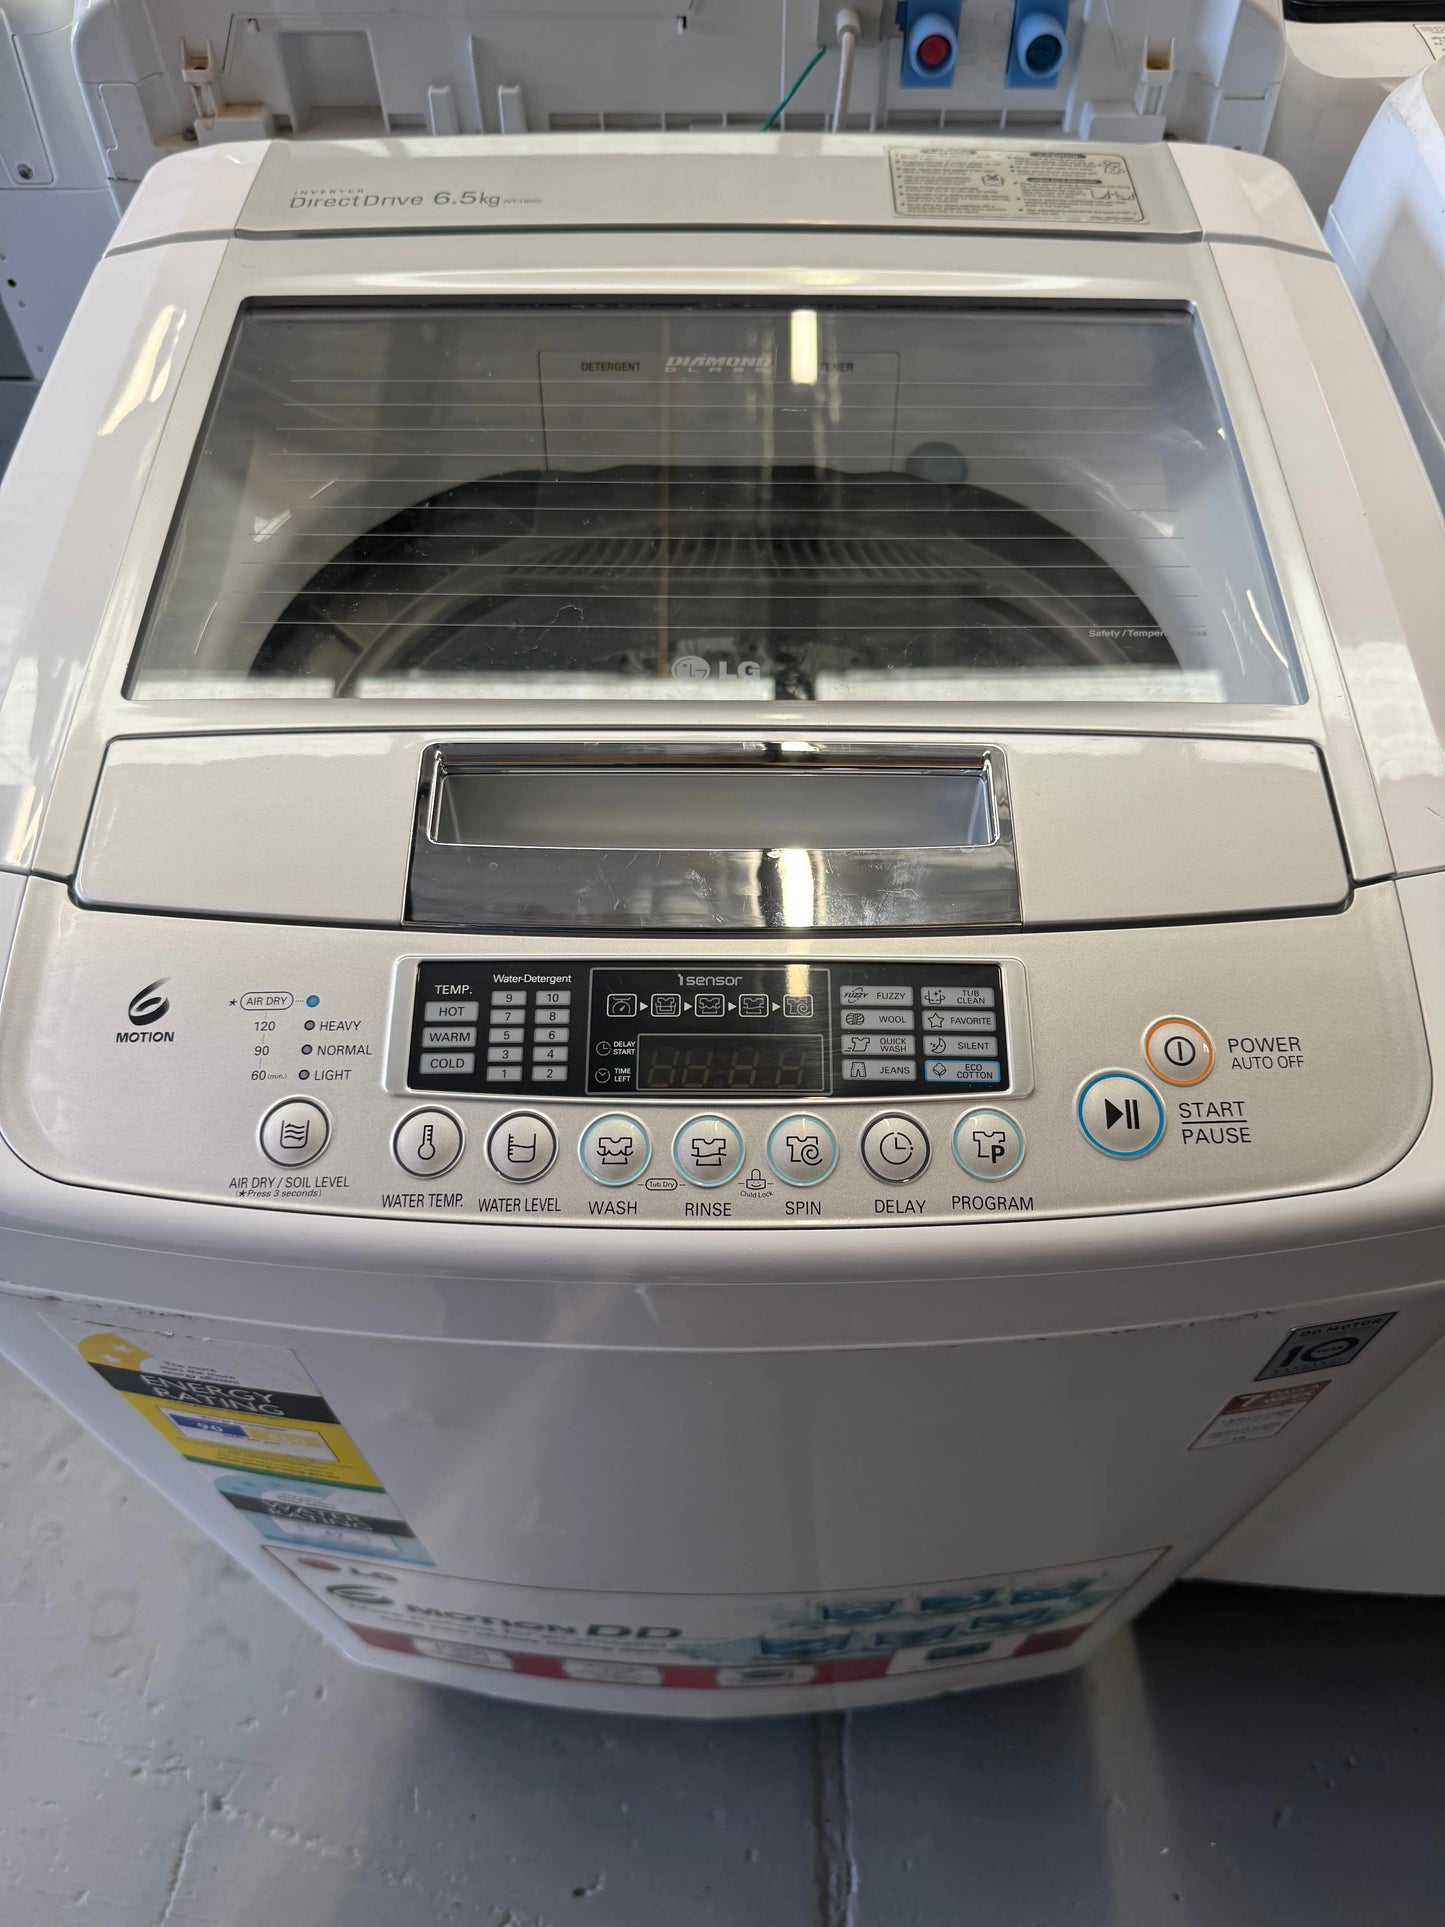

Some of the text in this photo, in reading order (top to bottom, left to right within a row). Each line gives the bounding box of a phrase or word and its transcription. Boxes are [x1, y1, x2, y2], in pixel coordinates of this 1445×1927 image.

[580, 361, 640, 372] DETERGENT
[1088, 629, 1120, 639] Safety
[718, 660, 762, 681] LG
[493, 974, 572, 985] Water-Detergent
[434, 985, 473, 995] TEMP.
[245, 996, 288, 1007] AIR DRY
[505, 993, 513, 1003] 9
[547, 993, 559, 1003] 10
[876, 992, 906, 1000] FUZZY
[956, 997, 986, 1005] CLEAN
[439, 1006, 465, 1017] HOT
[505, 1012, 512, 1022] 7
[549, 1012, 557, 1022] 8
[879, 1015, 907, 1024] WOOL
[950, 1016, 992, 1025] FAVORITE
[254, 1021, 276, 1032] 120
[319, 1020, 362, 1032] HEAVY
[115, 1031, 175, 1043] MOTION
[429, 1032, 470, 1042] WARM
[503, 1030, 511, 1040] 5
[548, 1030, 556, 1040] 6
[879, 1037, 907, 1046] QUICK
[957, 1041, 990, 1050] SILENT
[1227, 1036, 1302, 1053] POWER
[254, 1045, 270, 1056] 90
[317, 1044, 373, 1056] NORMAL
[502, 1049, 510, 1060] 3
[546, 1049, 554, 1059] 4
[880, 1045, 907, 1053] WASH
[430, 1058, 465, 1069] COLD
[965, 1063, 983, 1072] ECO
[1231, 1054, 1304, 1070] AUTO OFF
[251, 1070, 267, 1081] 60
[314, 1069, 352, 1081] LIGHT
[546, 1069, 554, 1079] 2
[614, 1067, 631, 1075] TIME
[879, 1066, 911, 1075] JEANS
[956, 1071, 993, 1080] COTTON
[1178, 1101, 1245, 1118] START
[1181, 1127, 1252, 1145] PAUSE
[229, 1177, 249, 1189] AIR
[250, 1177, 276, 1189] DRY
[286, 1176, 312, 1188] SOIL
[314, 1176, 350, 1188] LEVEL
[662, 1181, 675, 1189] Dry
[740, 1190, 774, 1198] Child Lock
[381, 1193, 463, 1208] WATER TEMP.
[478, 1198, 561, 1212] WATER LEVEL
[952, 1196, 1034, 1211] PROGRAM
[588, 1201, 638, 1215] WASH
[685, 1203, 732, 1217] RINSE
[785, 1201, 821, 1215] SPIN
[874, 1200, 926, 1214] DELAY
[1301, 1318, 1383, 1337] DD MOTOR
[1279, 1337, 1360, 1368] 10
[140, 1374, 275, 1403] ENERGY
[152, 1387, 285, 1416] RATING
[406, 1604, 577, 1634] MOTION
[586, 1624, 683, 1639] DD
